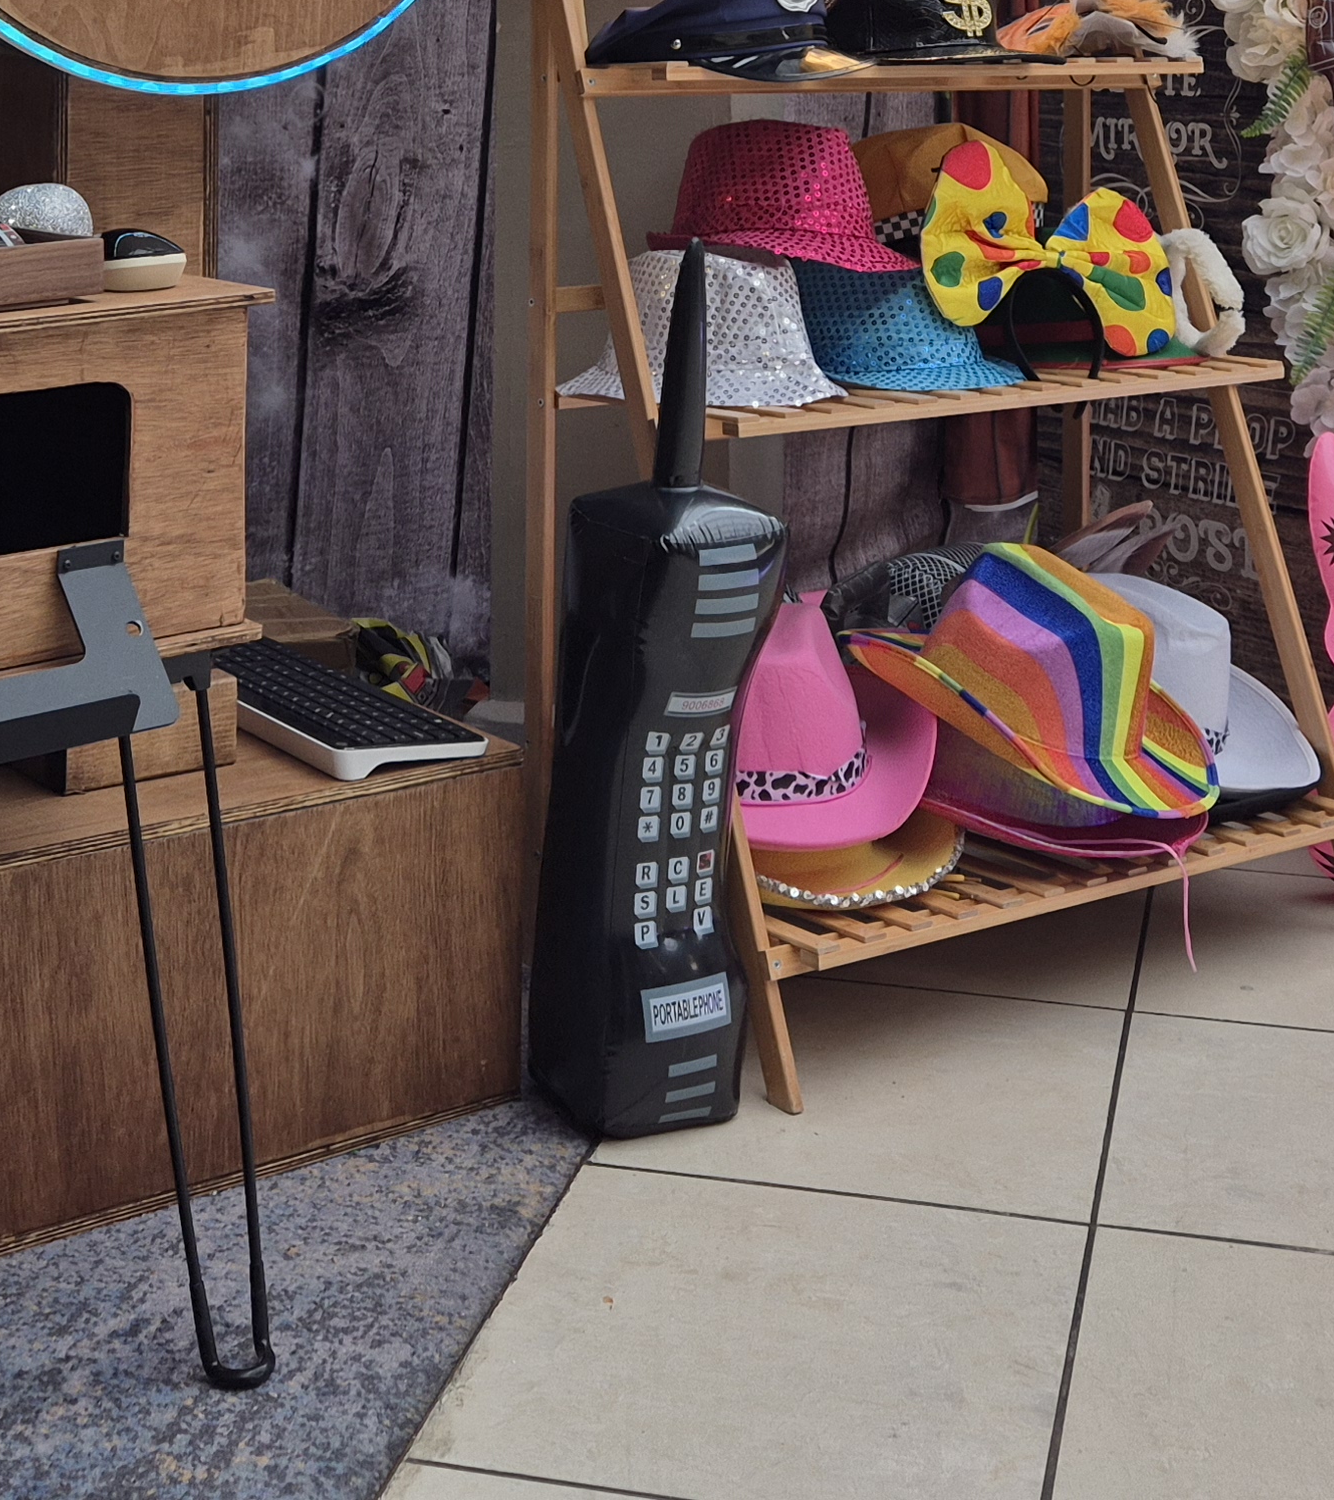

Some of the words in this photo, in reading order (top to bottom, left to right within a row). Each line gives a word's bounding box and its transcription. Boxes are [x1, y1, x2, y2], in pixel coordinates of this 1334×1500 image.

[1189, 403, 1296, 460] POP
[655, 734, 663, 748] 1
[685, 735, 697, 747] 2
[716, 728, 726, 741] 3
[648, 760, 657, 775] 4
[679, 758, 689, 773] 5
[709, 753, 718, 768] 6
[647, 789, 655, 805] 7
[677, 786, 686, 801] 8
[707, 781, 716, 796] 9
[641, 865, 651, 881] R
[673, 860, 683, 876] C
[640, 895, 650, 910] S
[673, 890, 679, 905] L
[699, 881, 707, 897] E
[640, 925, 650, 942] P
[697, 910, 706, 927] V
[653, 990, 724, 1026] PORTABLEPHONE
